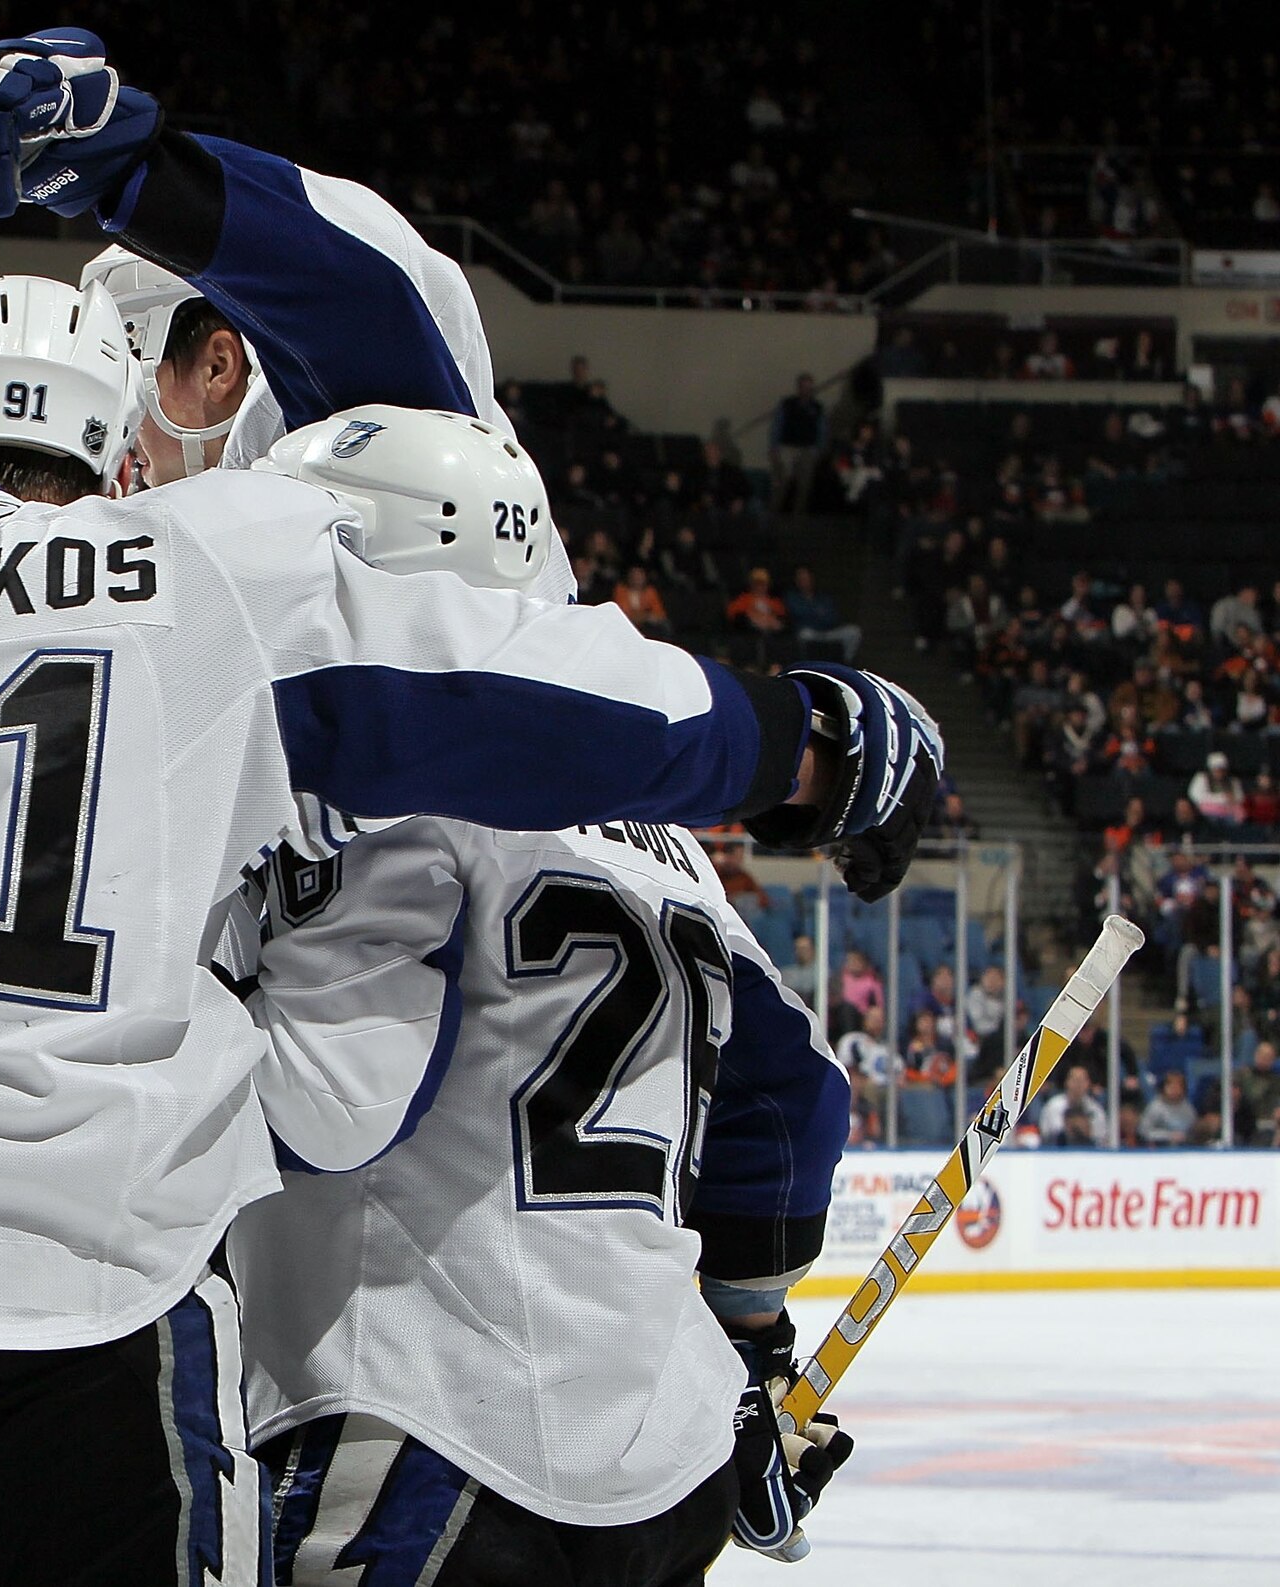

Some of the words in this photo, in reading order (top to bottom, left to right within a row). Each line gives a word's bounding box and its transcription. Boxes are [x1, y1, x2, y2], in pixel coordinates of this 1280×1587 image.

[30, 168, 80, 200] Reebok
[3, 380, 49, 424] 91
[492, 500, 527, 542] 26
[504, 869, 734, 1227] 26
[1044, 1178, 1147, 1231] State
[1151, 1179, 1263, 1229] Farm
